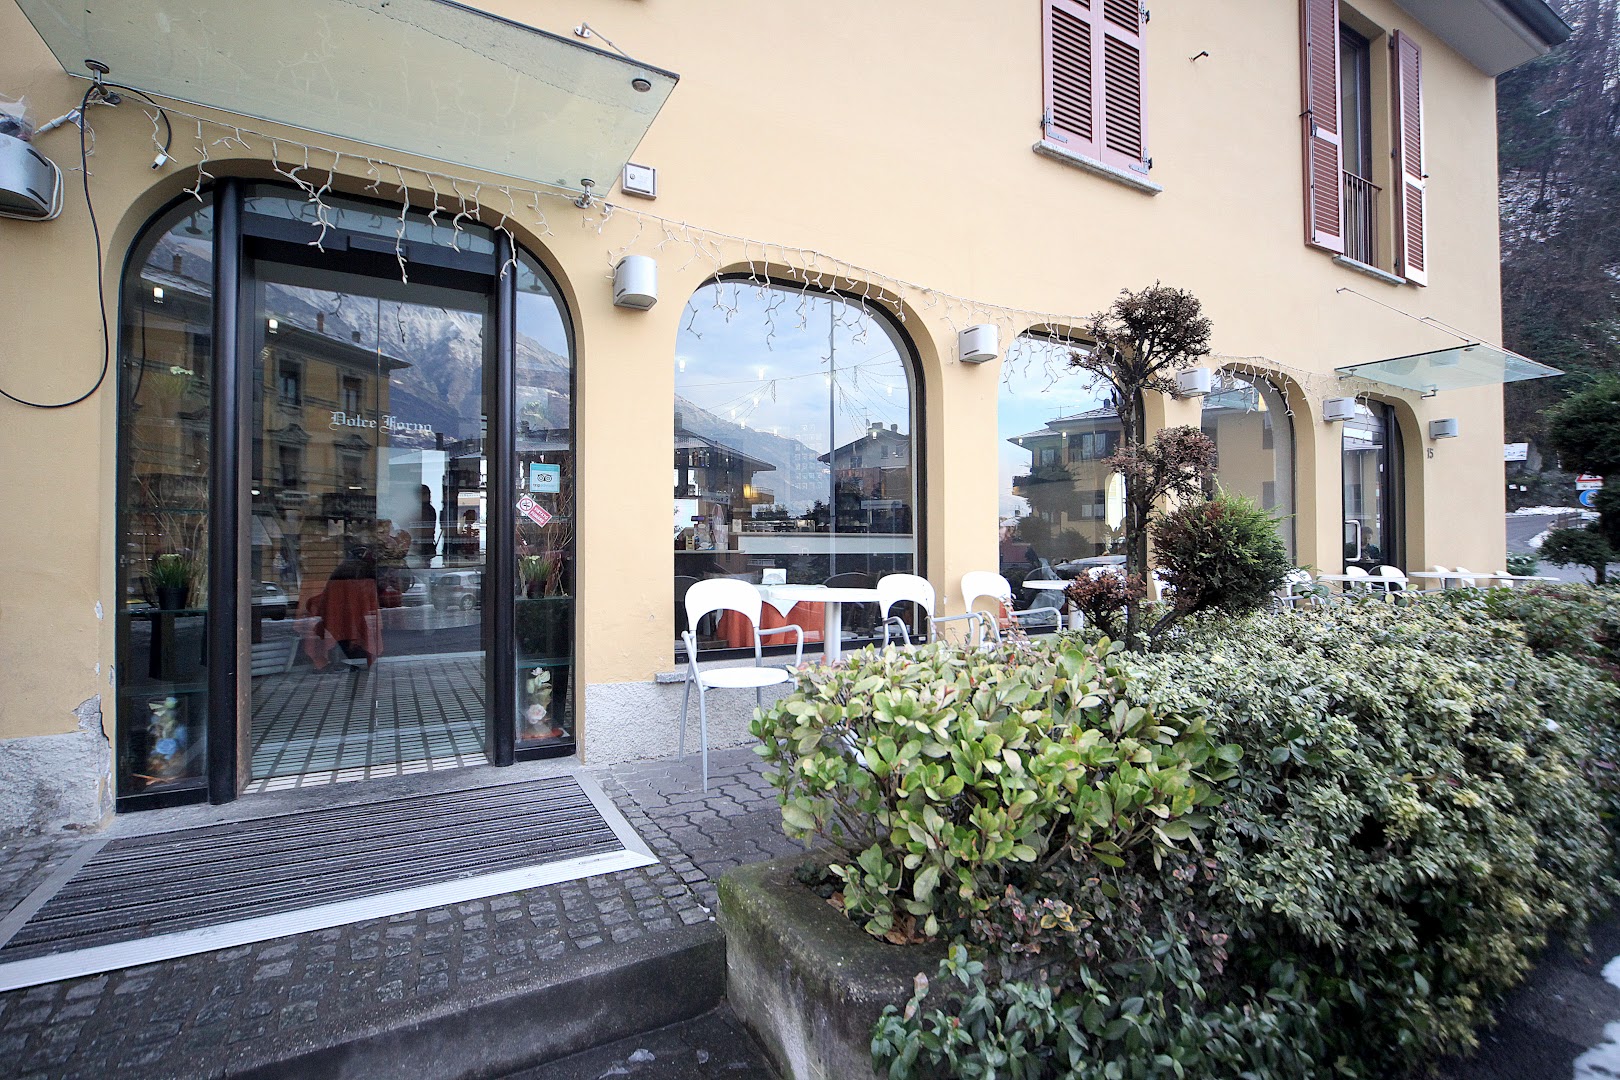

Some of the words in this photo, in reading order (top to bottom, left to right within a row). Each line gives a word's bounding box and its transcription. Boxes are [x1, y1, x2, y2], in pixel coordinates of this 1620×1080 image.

[328, 411, 377, 430] Dolce
[379, 415, 432, 434] Forno
[1426, 447, 1434, 459] 15
